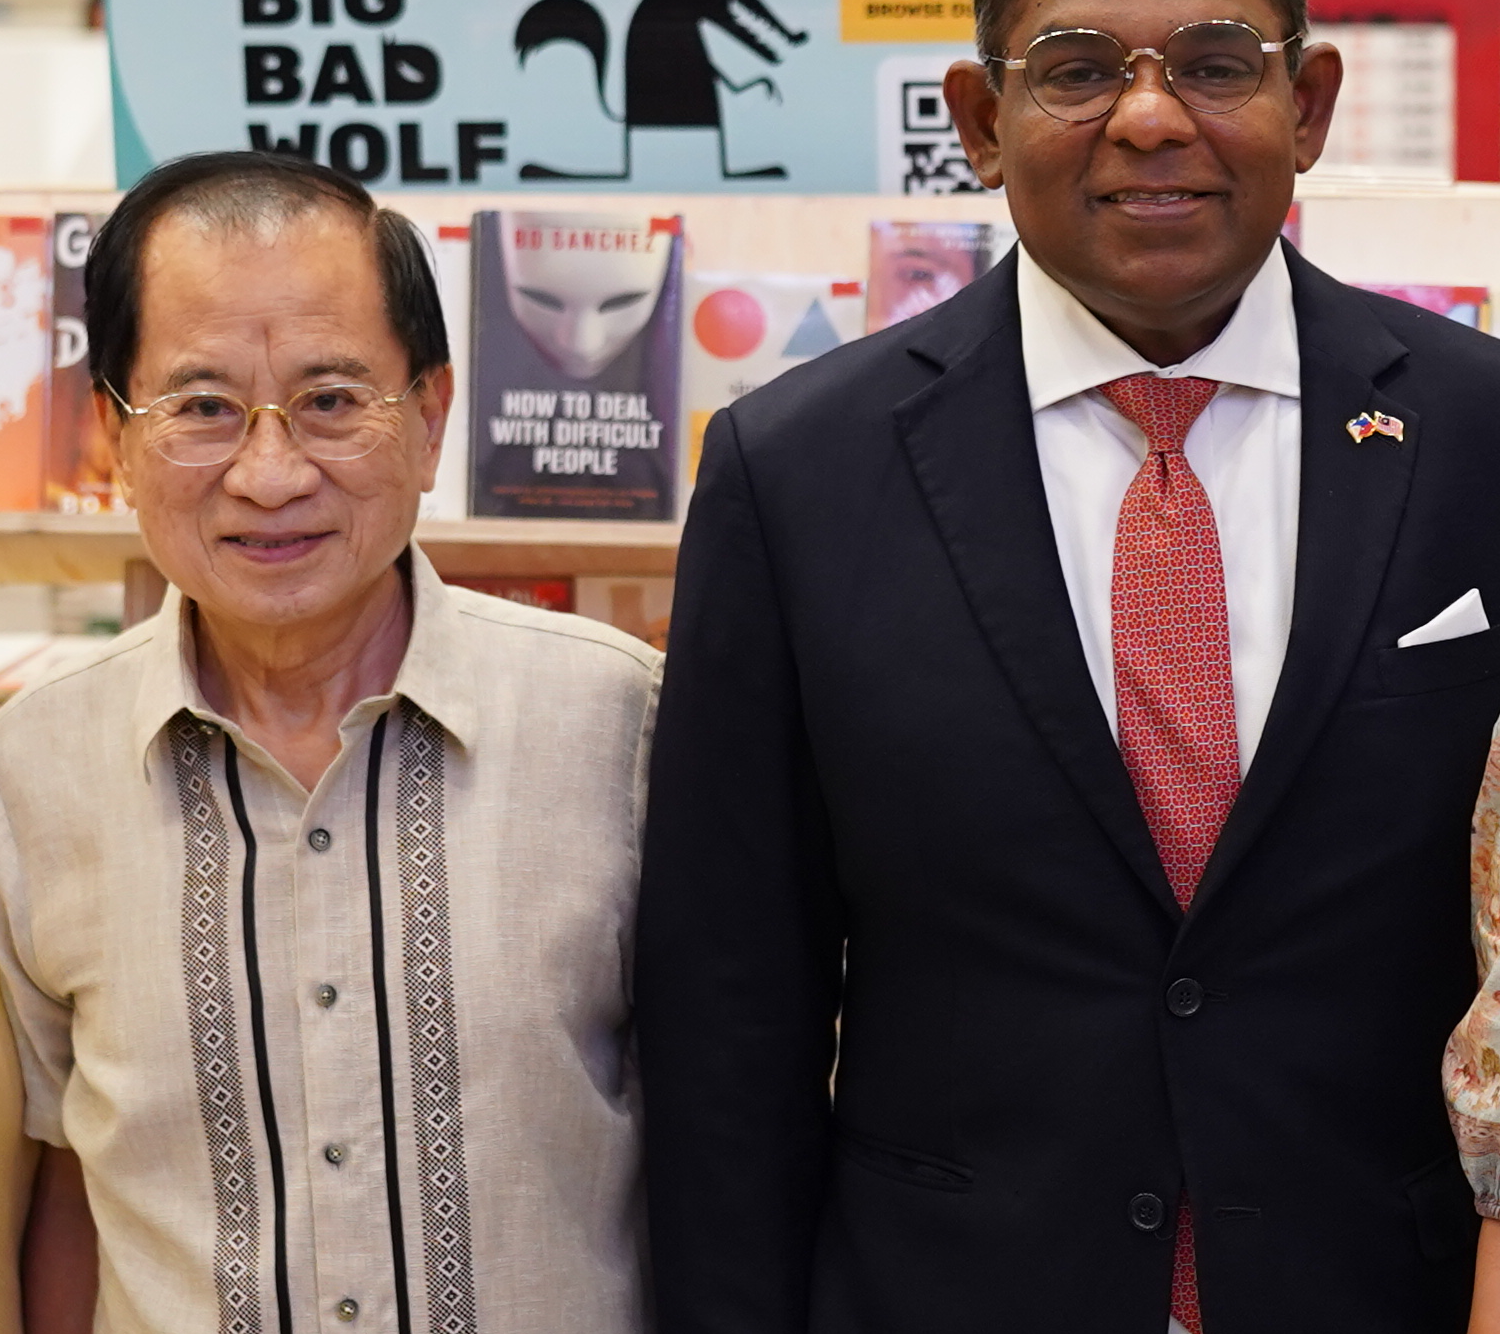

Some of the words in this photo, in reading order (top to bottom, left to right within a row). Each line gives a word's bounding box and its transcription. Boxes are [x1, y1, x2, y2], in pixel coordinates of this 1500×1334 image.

[243, 31, 443, 105] BAD
[248, 121, 507, 184] WOLF
[552, 229, 655, 254] SANCHEZ
[502, 390, 557, 417] HOW
[562, 393, 592, 418] TO
[595, 393, 652, 420] DEAL
[489, 419, 549, 446] WITH
[553, 421, 663, 449] DIFFICULT
[533, 446, 618, 475] PEOPLE
